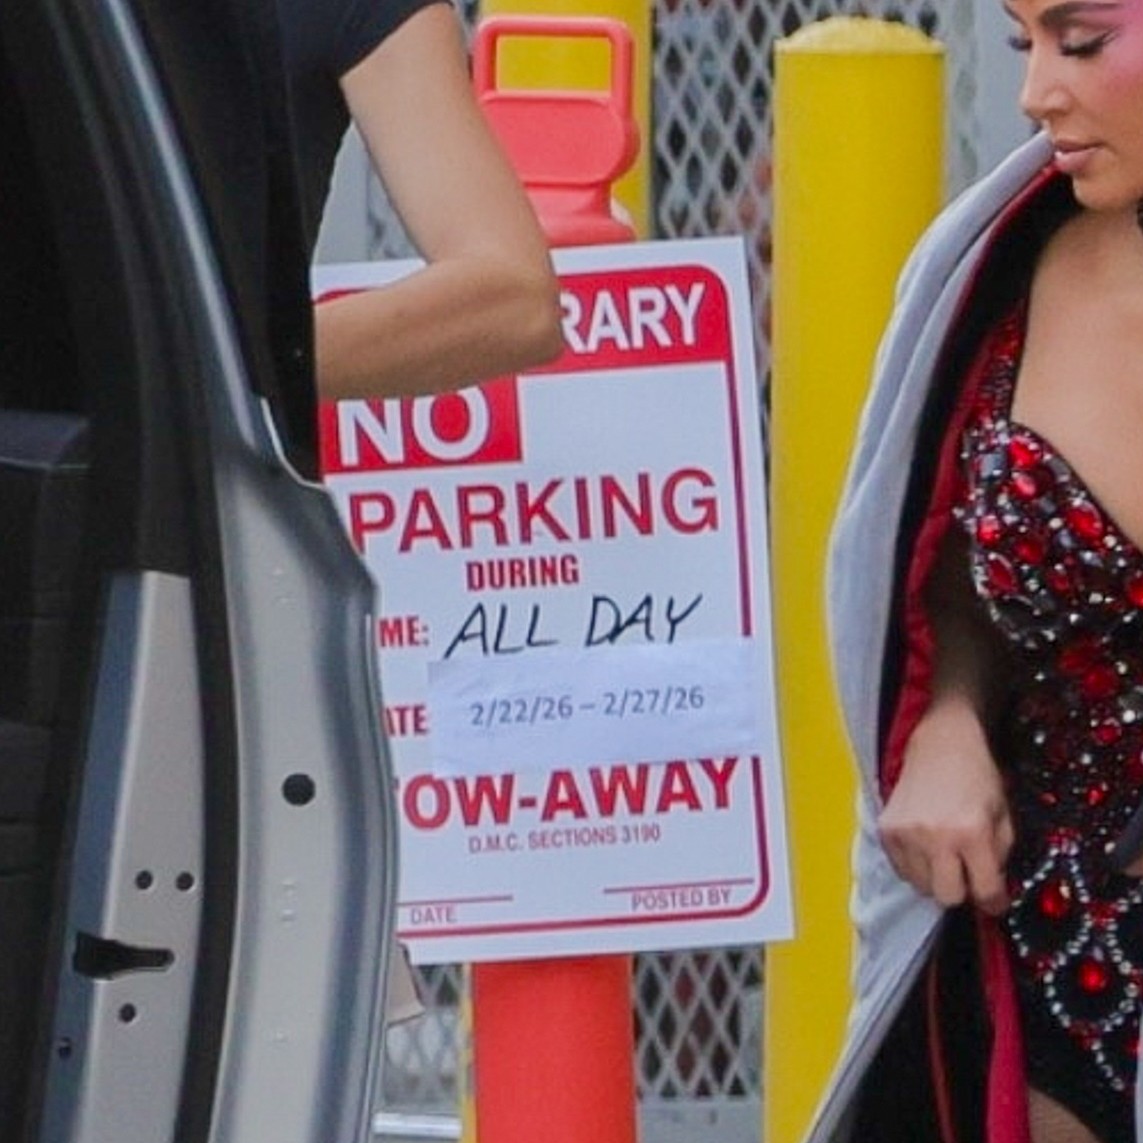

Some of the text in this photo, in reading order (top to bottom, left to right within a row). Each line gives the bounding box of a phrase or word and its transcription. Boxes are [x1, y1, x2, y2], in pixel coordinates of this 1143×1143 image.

[559, 282, 706, 355] RARY
[337, 387, 492, 467] NO
[348, 468, 720, 555] PARKING
[466, 555, 580, 592] DURING
[378, 615, 430, 648] ME:
[442, 594, 703, 659] ALL DAY
[470, 693, 574, 728] 2/22/26
[603, 685, 705, 718] 2/27/26
[393, 755, 739, 831] OW-AWAY
[527, 825, 618, 850] SECTIONS
[410, 887, 733, 926] DATE POSTED BY
